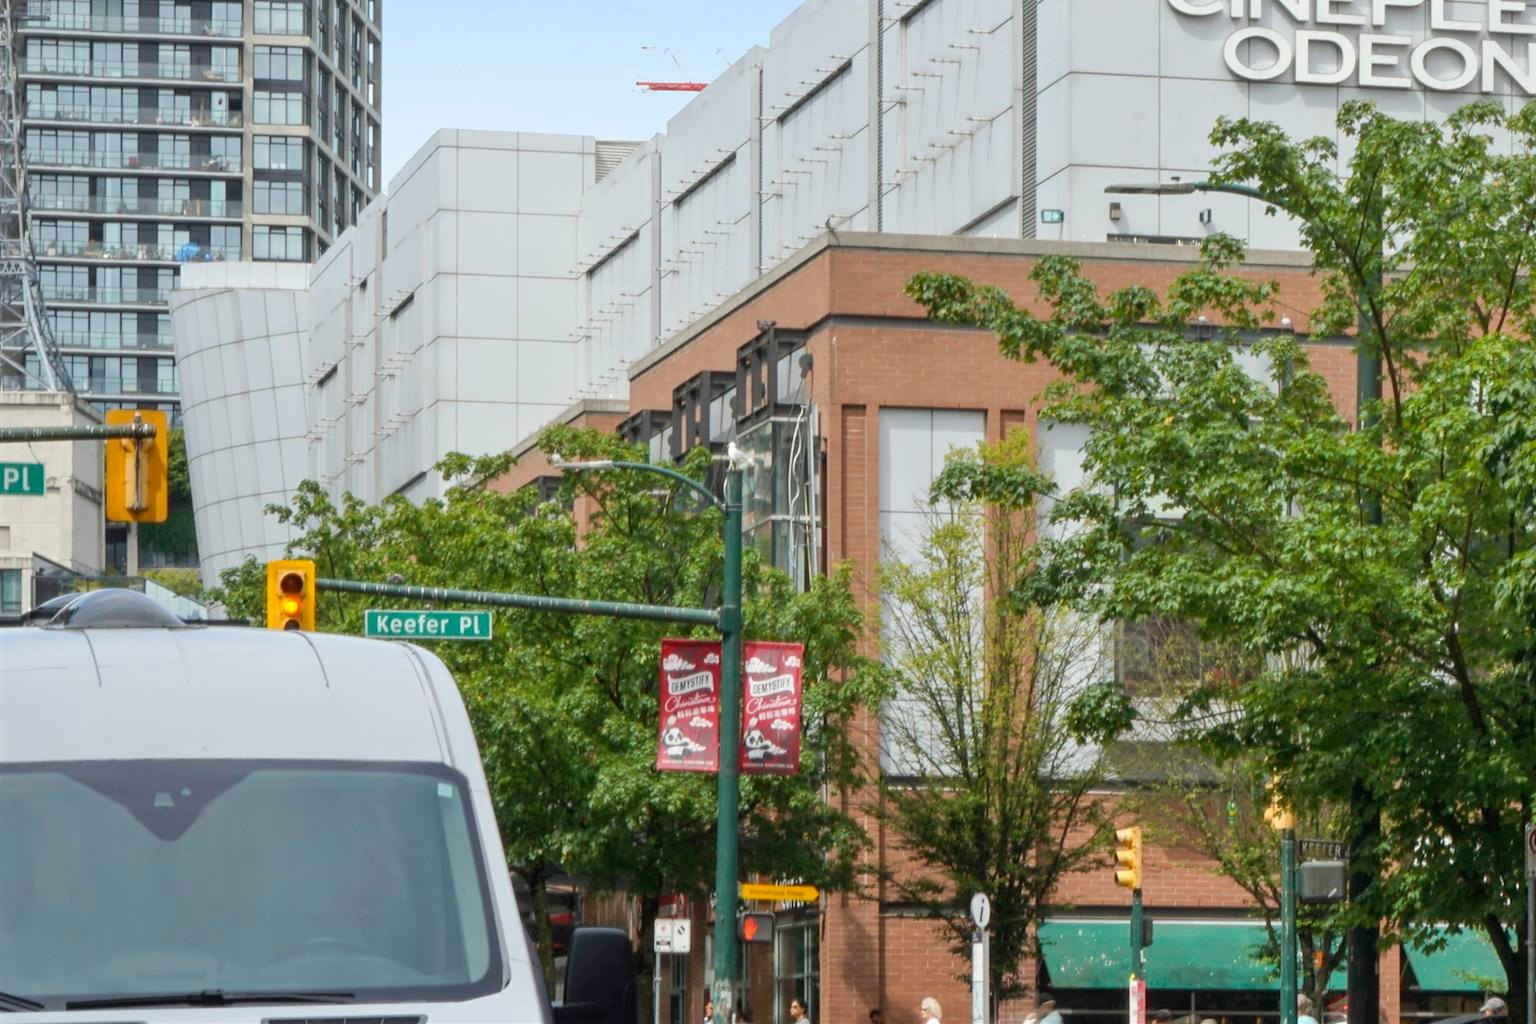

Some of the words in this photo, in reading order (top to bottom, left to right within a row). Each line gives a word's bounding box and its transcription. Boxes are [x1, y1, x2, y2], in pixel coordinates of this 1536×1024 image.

[4, 466, 31, 492] Pl
[377, 614, 449, 634] Keefer
[460, 615, 480, 635] Pl
[671, 674, 709, 693] DEMYSTIFY
[753, 677, 790, 695] DEMYSTIFY
